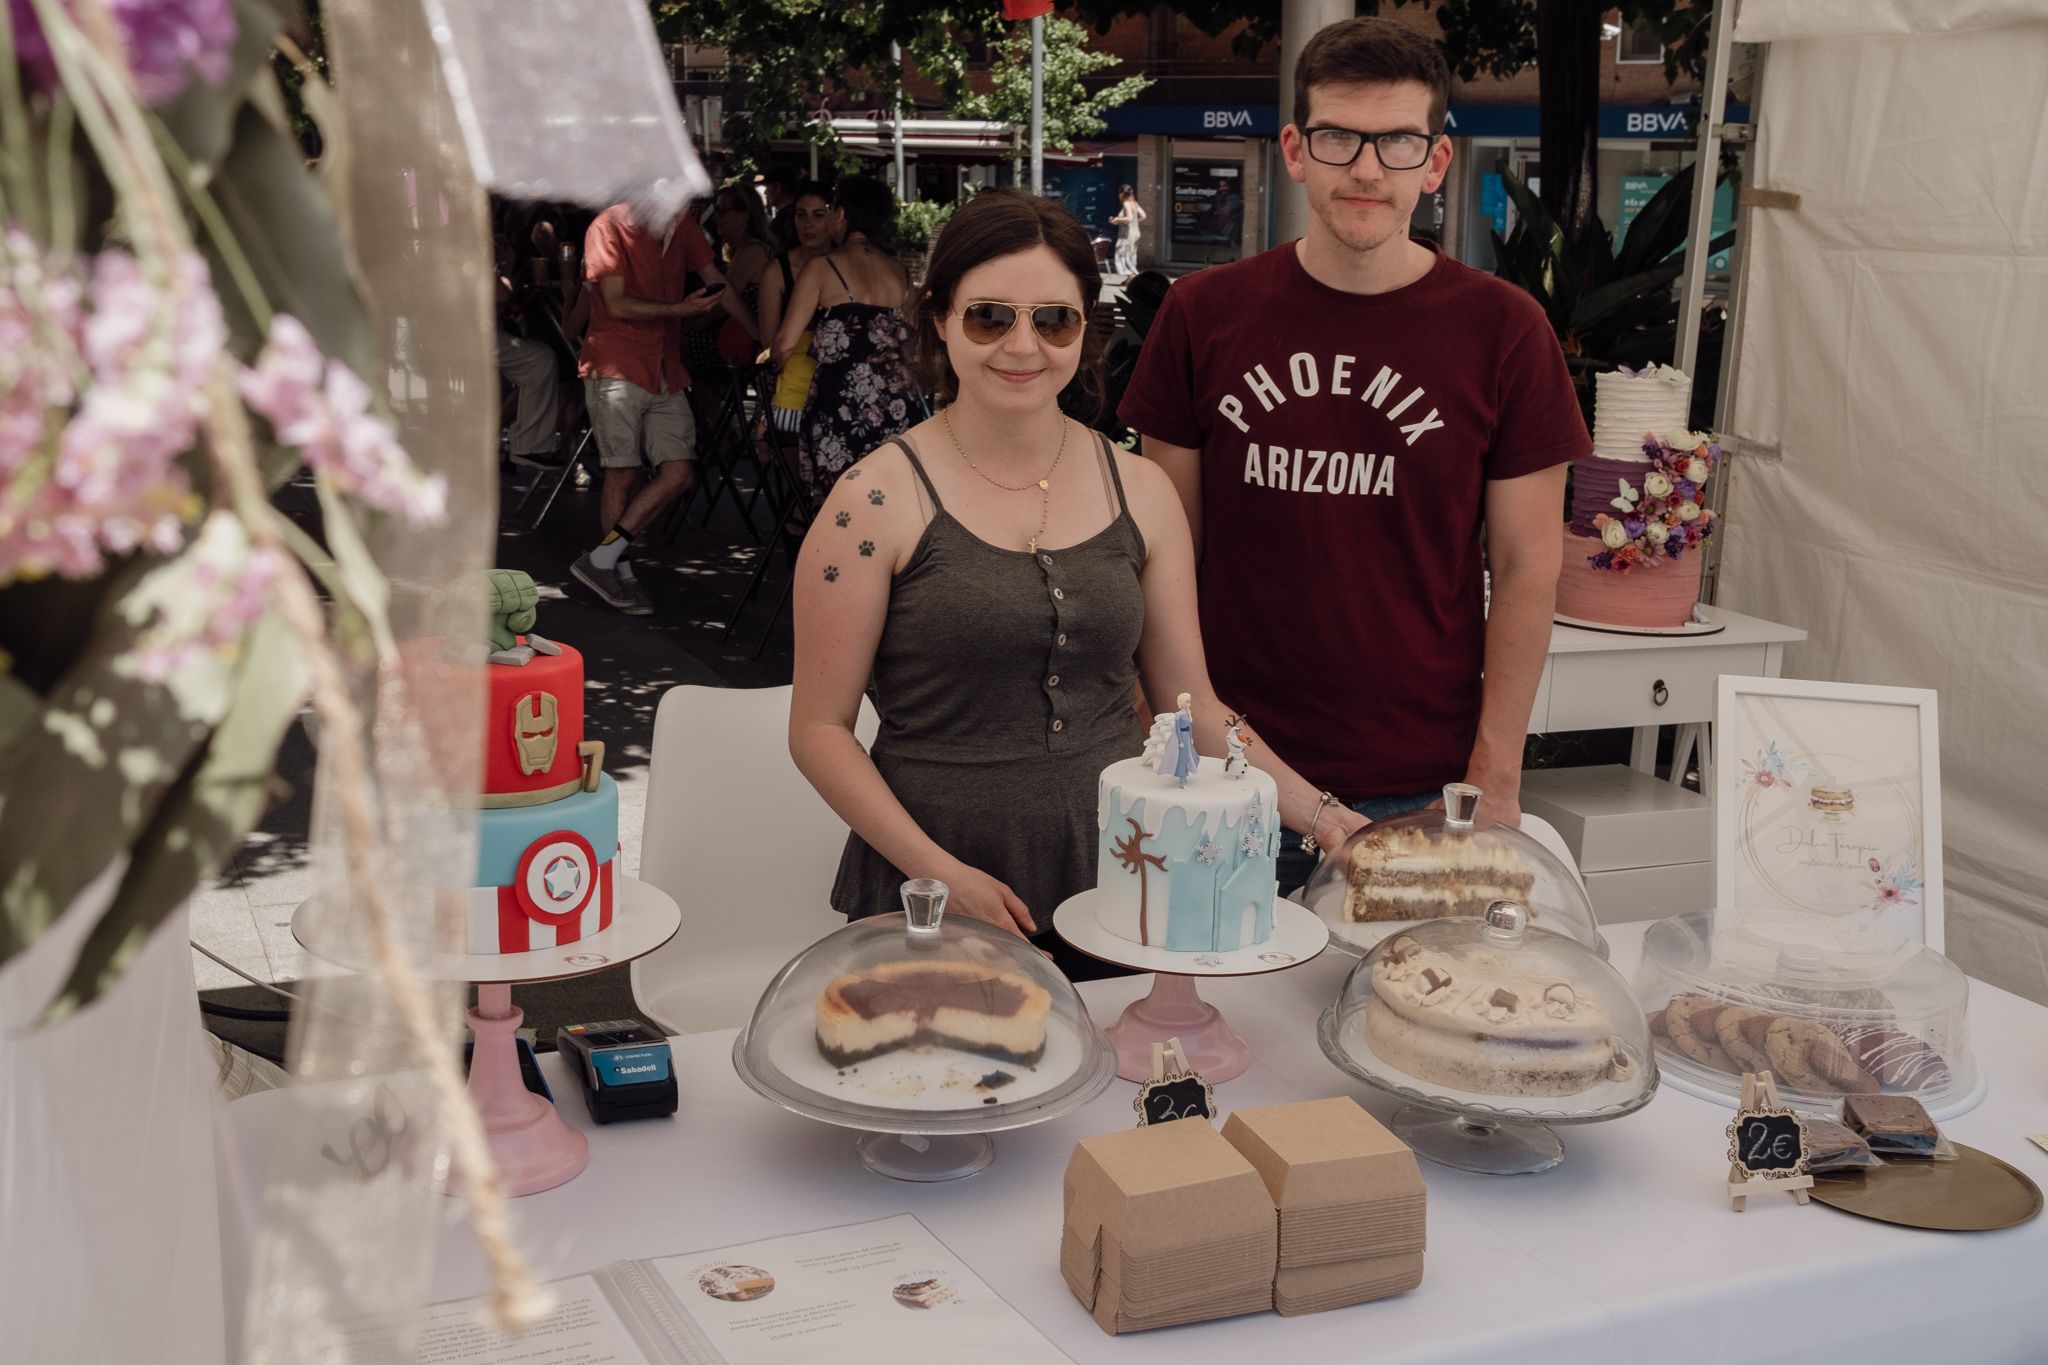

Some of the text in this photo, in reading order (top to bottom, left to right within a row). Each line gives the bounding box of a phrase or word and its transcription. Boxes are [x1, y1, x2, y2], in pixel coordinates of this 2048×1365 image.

[1203, 111, 1252, 128] BBVA
[1627, 112, 1689, 132] BBVA
[1218, 352, 1445, 447] PHOENIX
[1244, 442, 1396, 497] ARIZONA
[578, 740, 605, 793] 7
[620, 1064, 657, 1074] Sabadell
[1747, 1121, 1793, 1161] 2€
